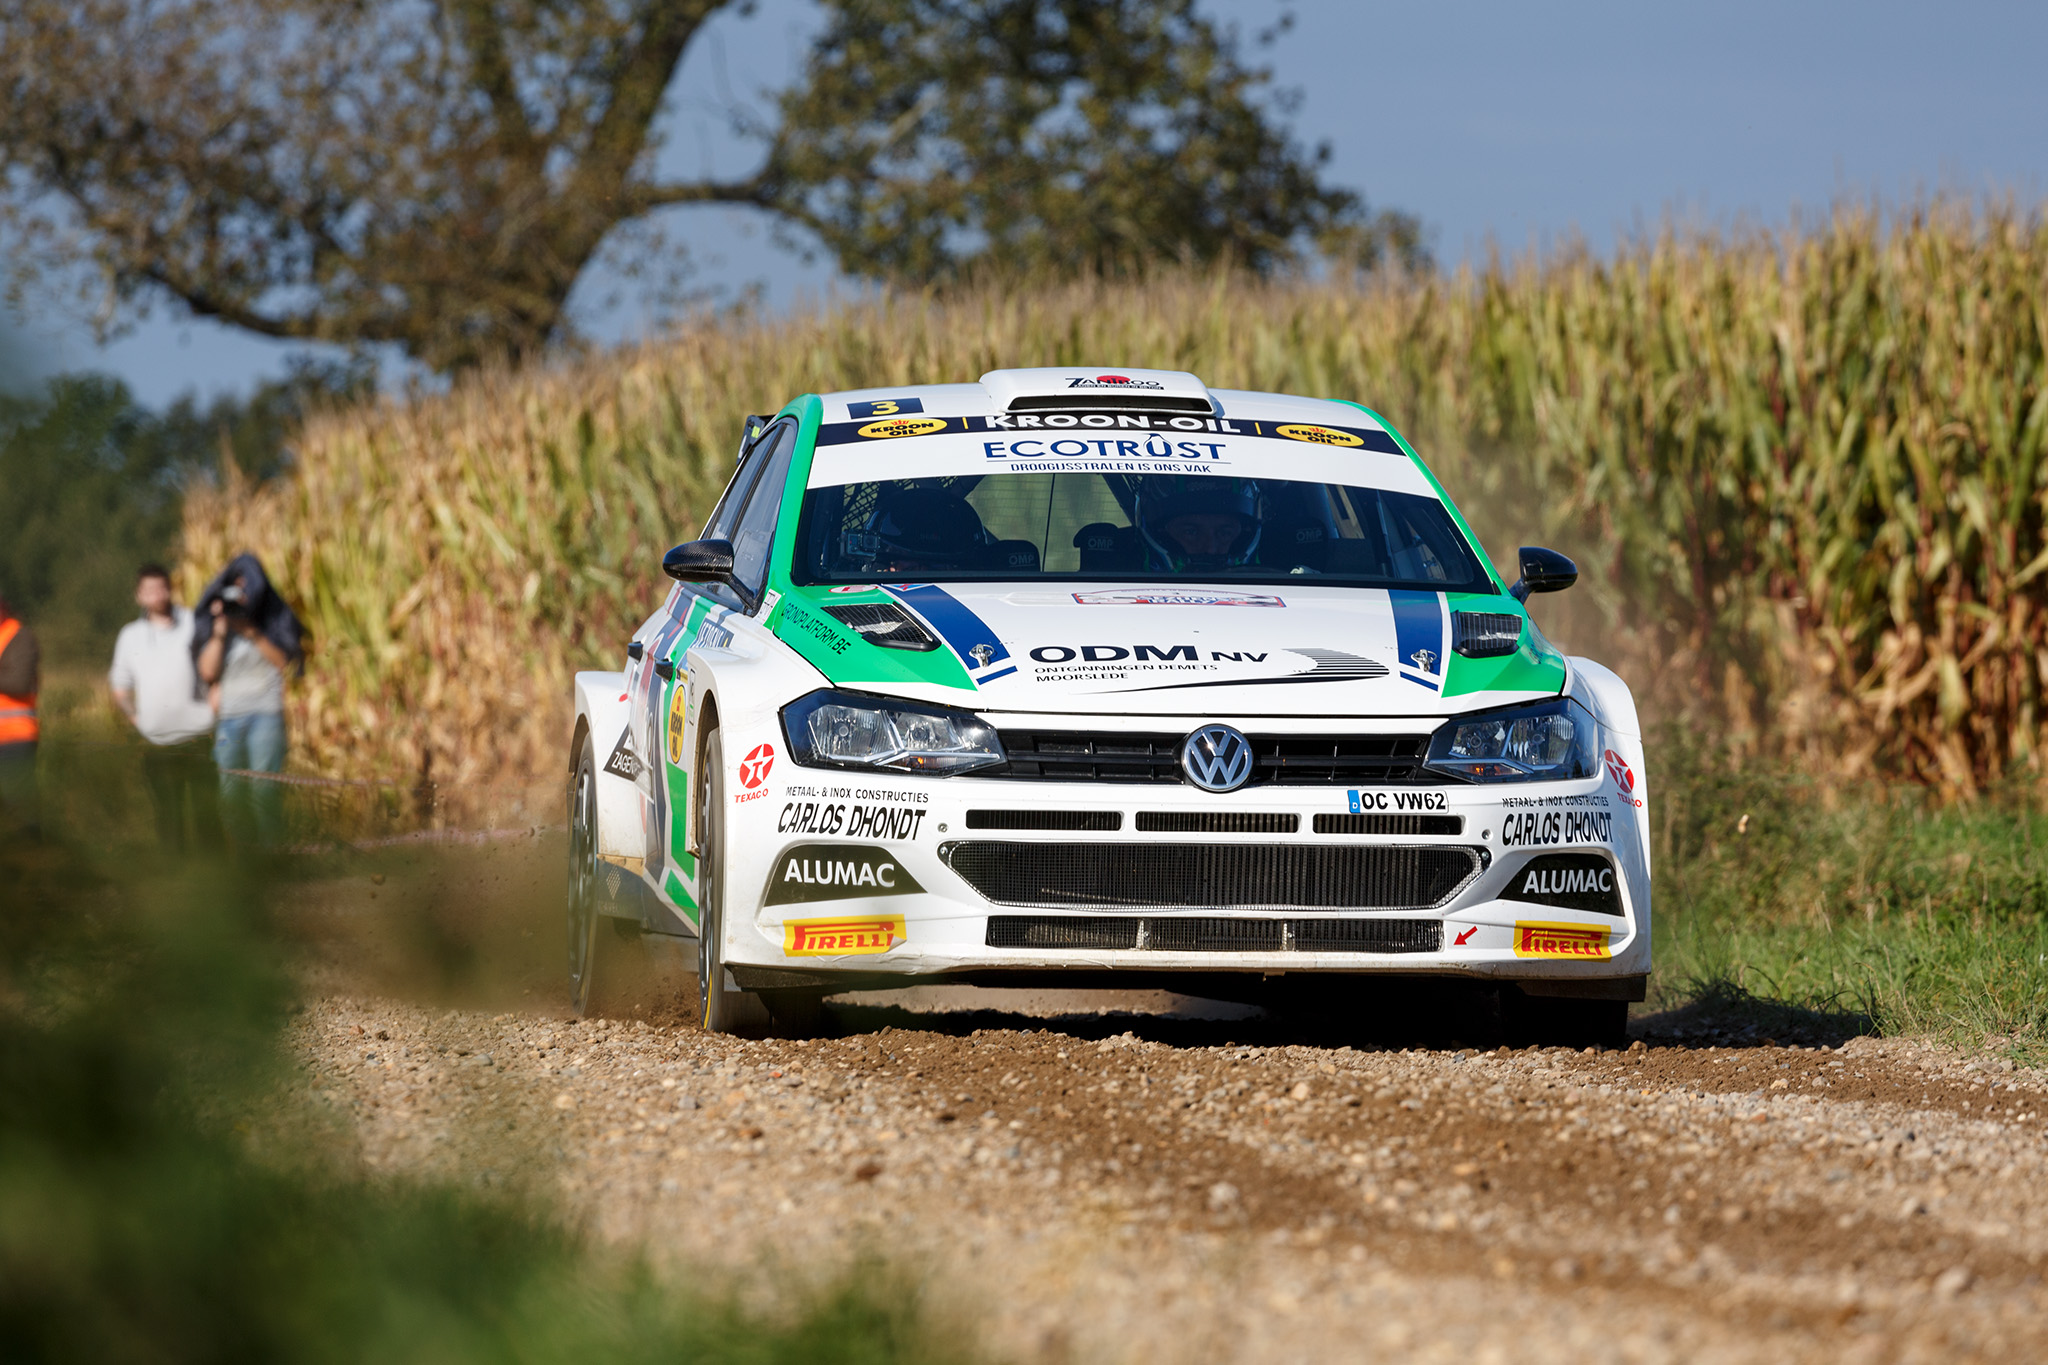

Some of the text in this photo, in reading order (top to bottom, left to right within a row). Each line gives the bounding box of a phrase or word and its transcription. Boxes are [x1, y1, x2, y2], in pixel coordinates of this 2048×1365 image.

[872, 400, 900, 415] 3
[870, 422, 934, 433] KROON
[985, 414, 1241, 433] KROON-OIL
[889, 428, 917, 436] OIL
[1288, 428, 1352, 442] KROON
[1307, 436, 1335, 445] OIL
[983, 438, 1226, 459] ECOTRUST
[1138, 463, 1150, 472] IS
[1155, 464, 1180, 472] ONS
[1184, 464, 1212, 473] VAK
[1087, 537, 1114, 549] OMP
[1008, 553, 1035, 565] OMP
[1029, 645, 1269, 663] ODM NV
[1034, 664, 1148, 674] ONTGINNINGEN
[1036, 672, 1129, 682] MOORSLEDE
[734, 788, 769, 803] TEXACO
[785, 786, 929, 803] METAAL- & INOX CONSTRUCTIES
[1361, 792, 1446, 810] OC VW62
[1502, 795, 1609, 808] METAAL- & INOX CONSTRUCTIES
[1616, 792, 1642, 808] TEXACO
[777, 802, 927, 840] CARLOS DHONDT
[1502, 812, 1614, 846] CARLOS DHONDT
[784, 858, 895, 887] ALUMAC
[1522, 868, 1612, 894] ALUMAC
[792, 921, 896, 950] PIRELLI
[1521, 927, 1603, 956] PIRELLI
